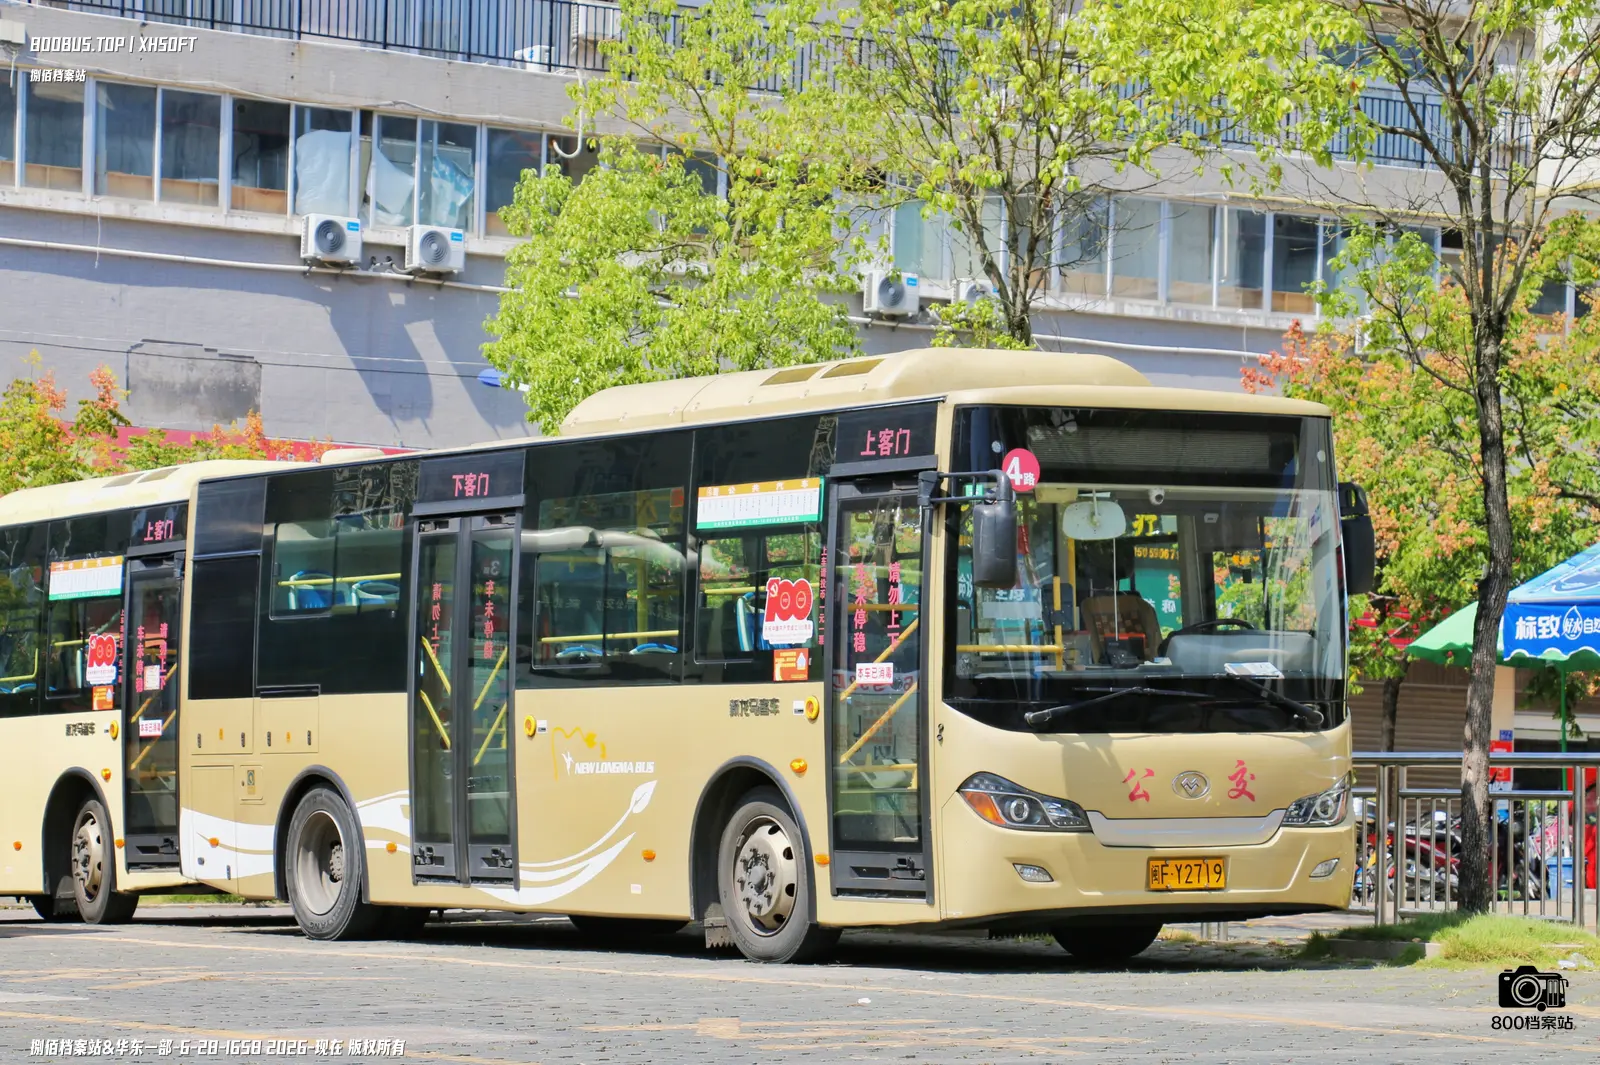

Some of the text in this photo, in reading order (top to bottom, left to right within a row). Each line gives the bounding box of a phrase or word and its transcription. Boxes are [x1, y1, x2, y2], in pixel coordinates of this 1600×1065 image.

[860, 428, 911, 456] 上客门
[452, 473, 490, 497] 下客门
[1006, 456, 1035, 486] 4路
[144, 520, 174, 541] 上客门
[853, 562, 867, 653] 车未停稳
[887, 561, 901, 652] 请勿上下
[1515, 614, 1562, 640] 标致
[574, 762, 596, 774] NEW
[635, 762, 654, 773] BUS
[1122, 760, 1256, 802] 公 交
